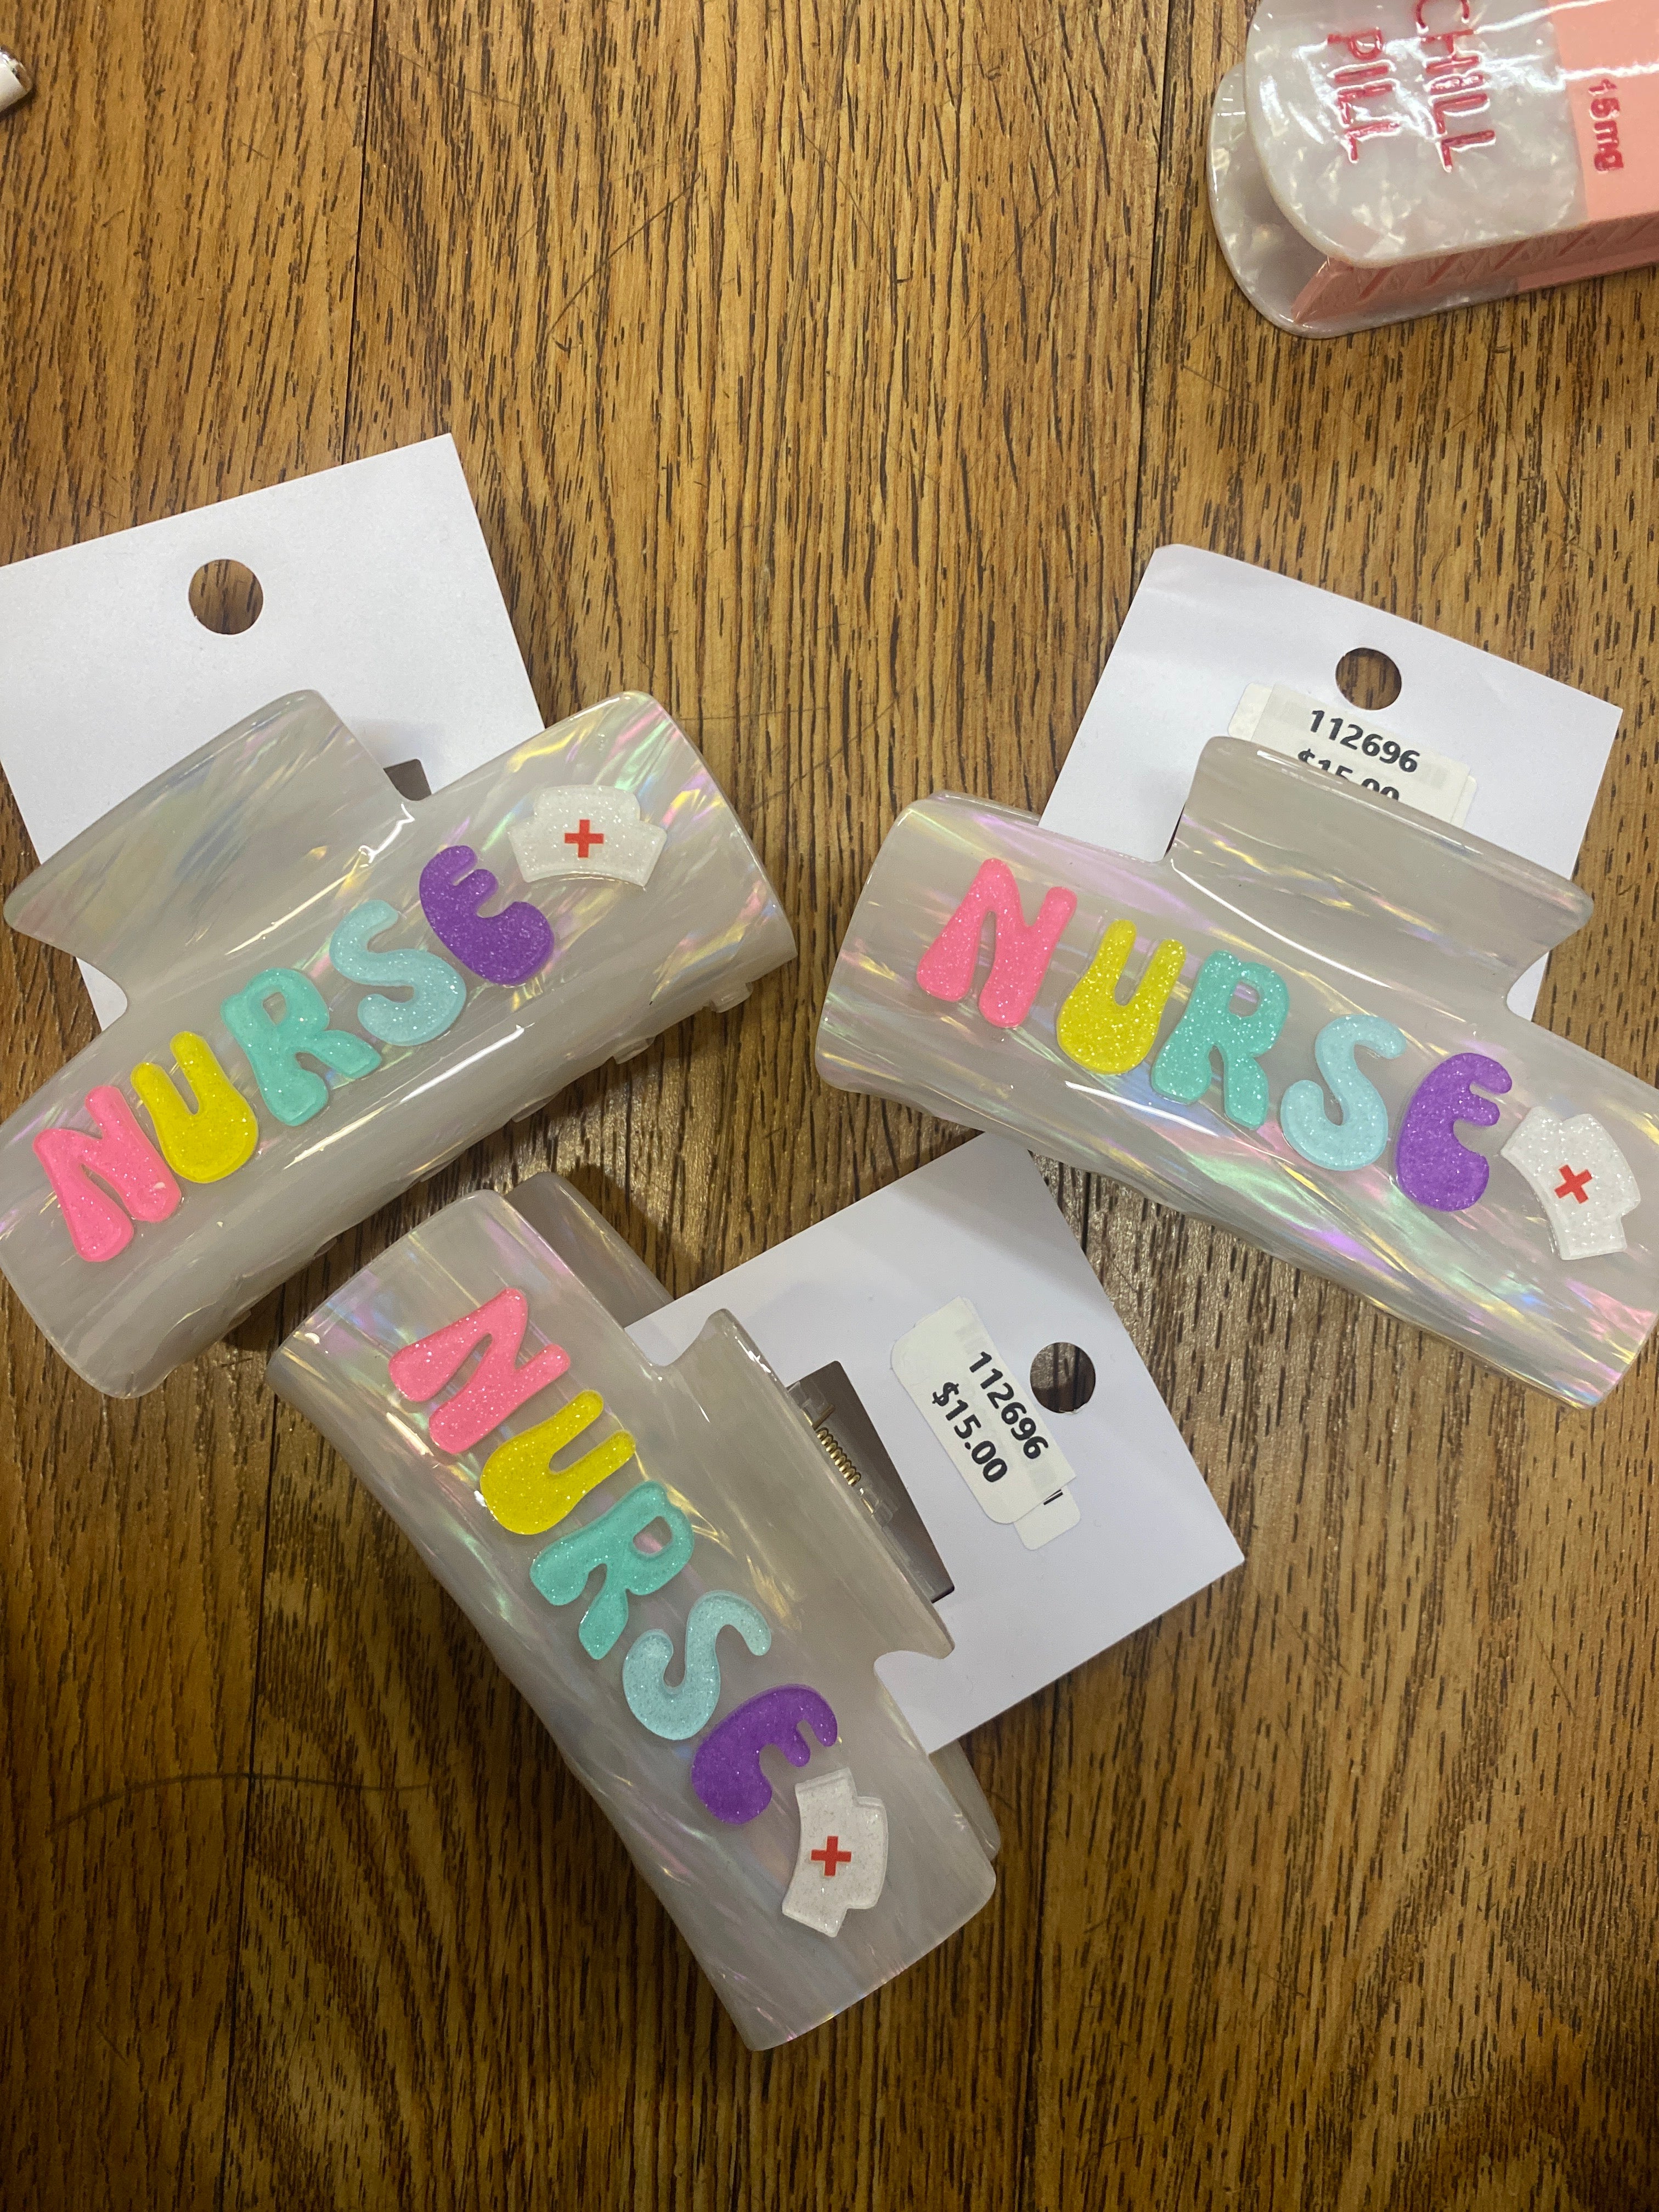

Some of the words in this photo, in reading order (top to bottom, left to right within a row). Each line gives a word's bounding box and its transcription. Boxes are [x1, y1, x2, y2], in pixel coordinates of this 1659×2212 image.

[1327, 27, 1400, 162] PILL
[1297, 748, 1400, 800] $1500
[1310, 710, 1421, 773] 112696
[33, 845, 555, 1262] NURSE
[917, 857, 1513, 1211] NURSE
[932, 1381, 1008, 1482] $15.00
[969, 1351, 1048, 1459] 112696
[388, 1286, 838, 1825] NURSE
